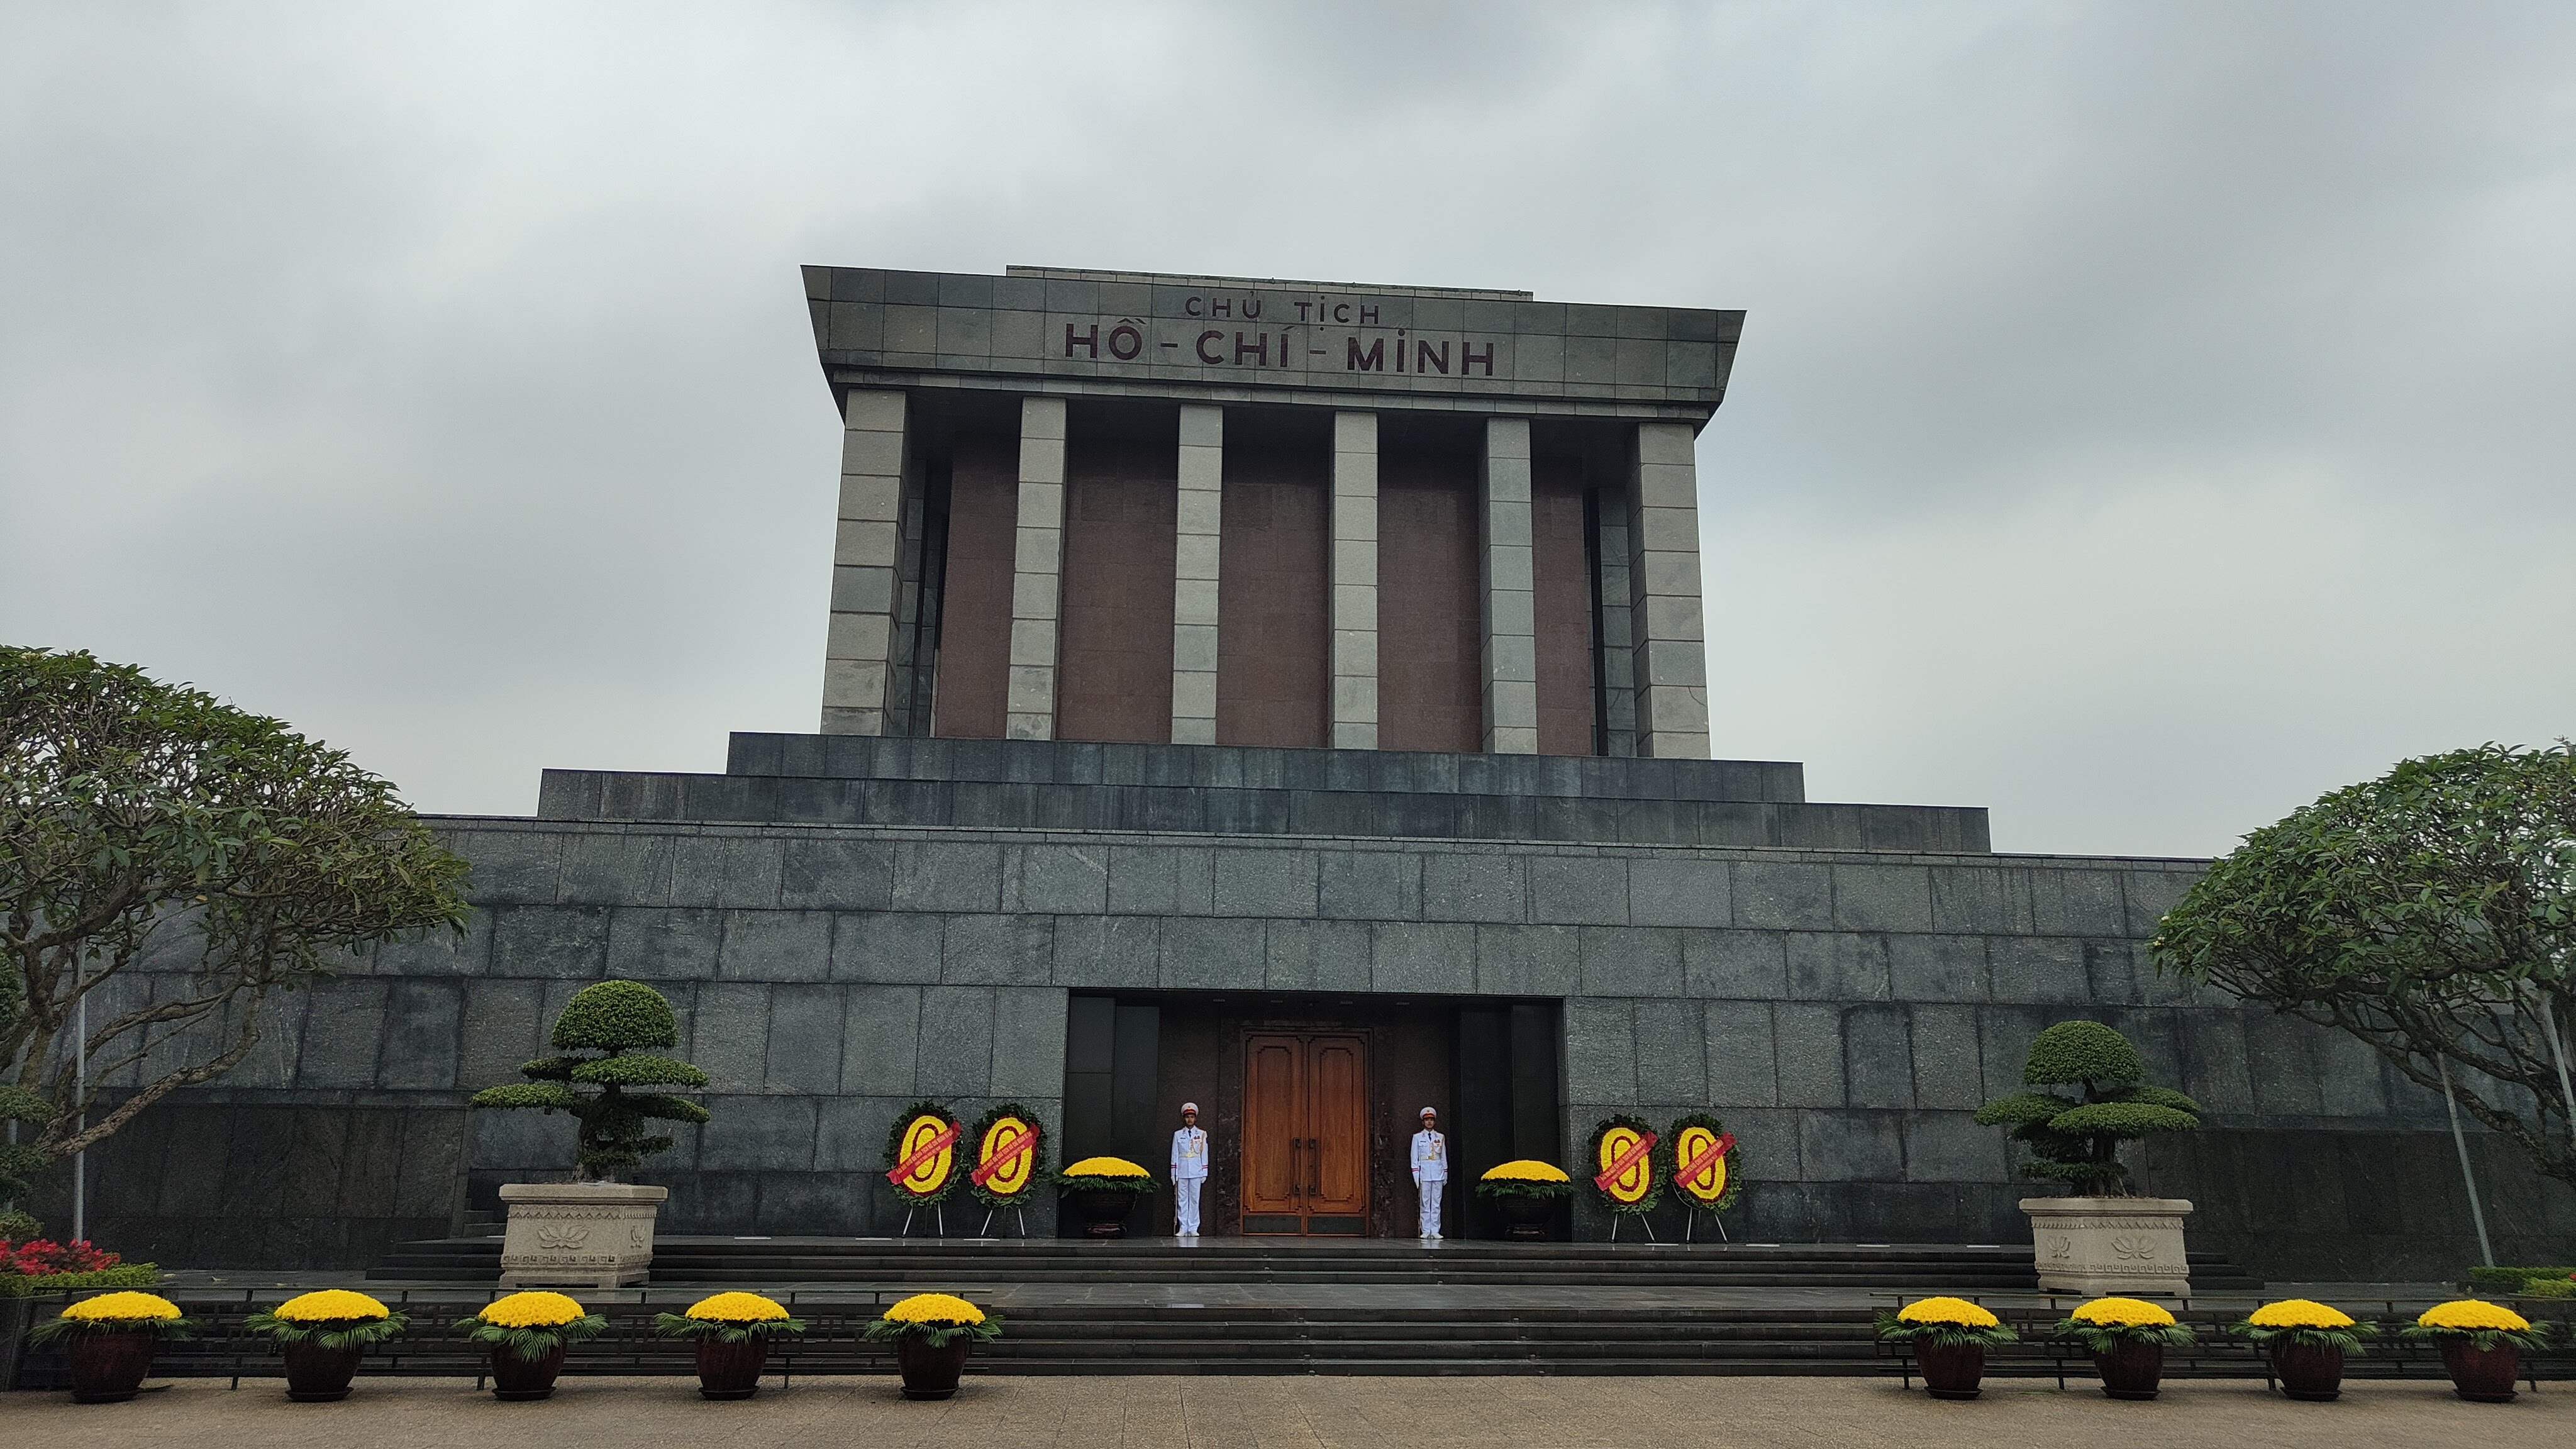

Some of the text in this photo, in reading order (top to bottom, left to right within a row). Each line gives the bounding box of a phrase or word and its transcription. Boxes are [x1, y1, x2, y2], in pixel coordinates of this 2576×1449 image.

[1185, 291, 1379, 331] CHỦ TỊCH
[1065, 318, 1146, 361] HỒ
[1196, 325, 1294, 368] CHÍ
